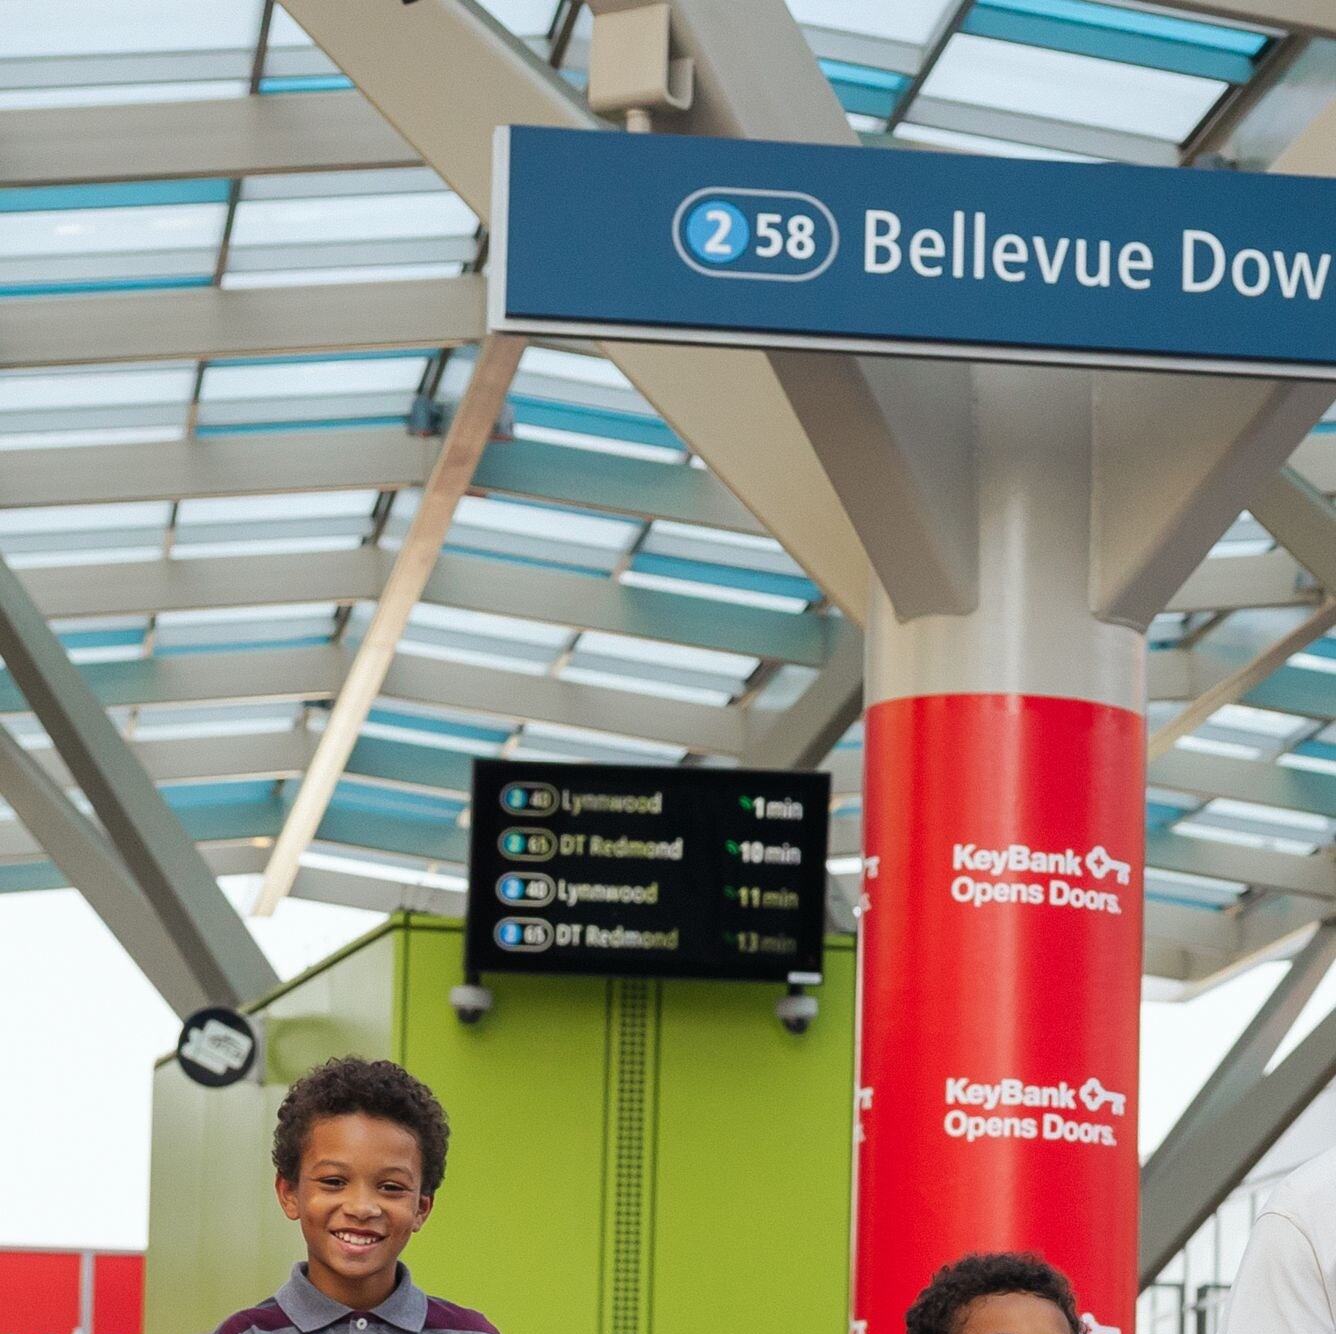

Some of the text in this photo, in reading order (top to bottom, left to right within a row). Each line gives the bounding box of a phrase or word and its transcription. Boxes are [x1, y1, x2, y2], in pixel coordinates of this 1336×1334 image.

[704, 209, 1332, 300] 2 58 Bellevue Dow
[561, 789, 662, 816] Lynnwood
[753, 796, 765, 819] 1
[766, 797, 803, 820] min
[560, 834, 587, 855] DT
[590, 835, 683, 860] Redmond
[740, 841, 764, 863] 10
[764, 842, 801, 865] min
[952, 844, 1083, 876] KeyBank
[557, 879, 658, 907] Lynnwood
[738, 886, 760, 908] 11
[763, 887, 799, 909] min
[951, 876, 1045, 908] Opens
[556, 923, 582, 946] DT
[586, 925, 679, 950] Redmond
[761, 933, 797, 954] min
[945, 1077, 1077, 1110] KeyBank
[944, 1110, 1038, 1142] Opens
